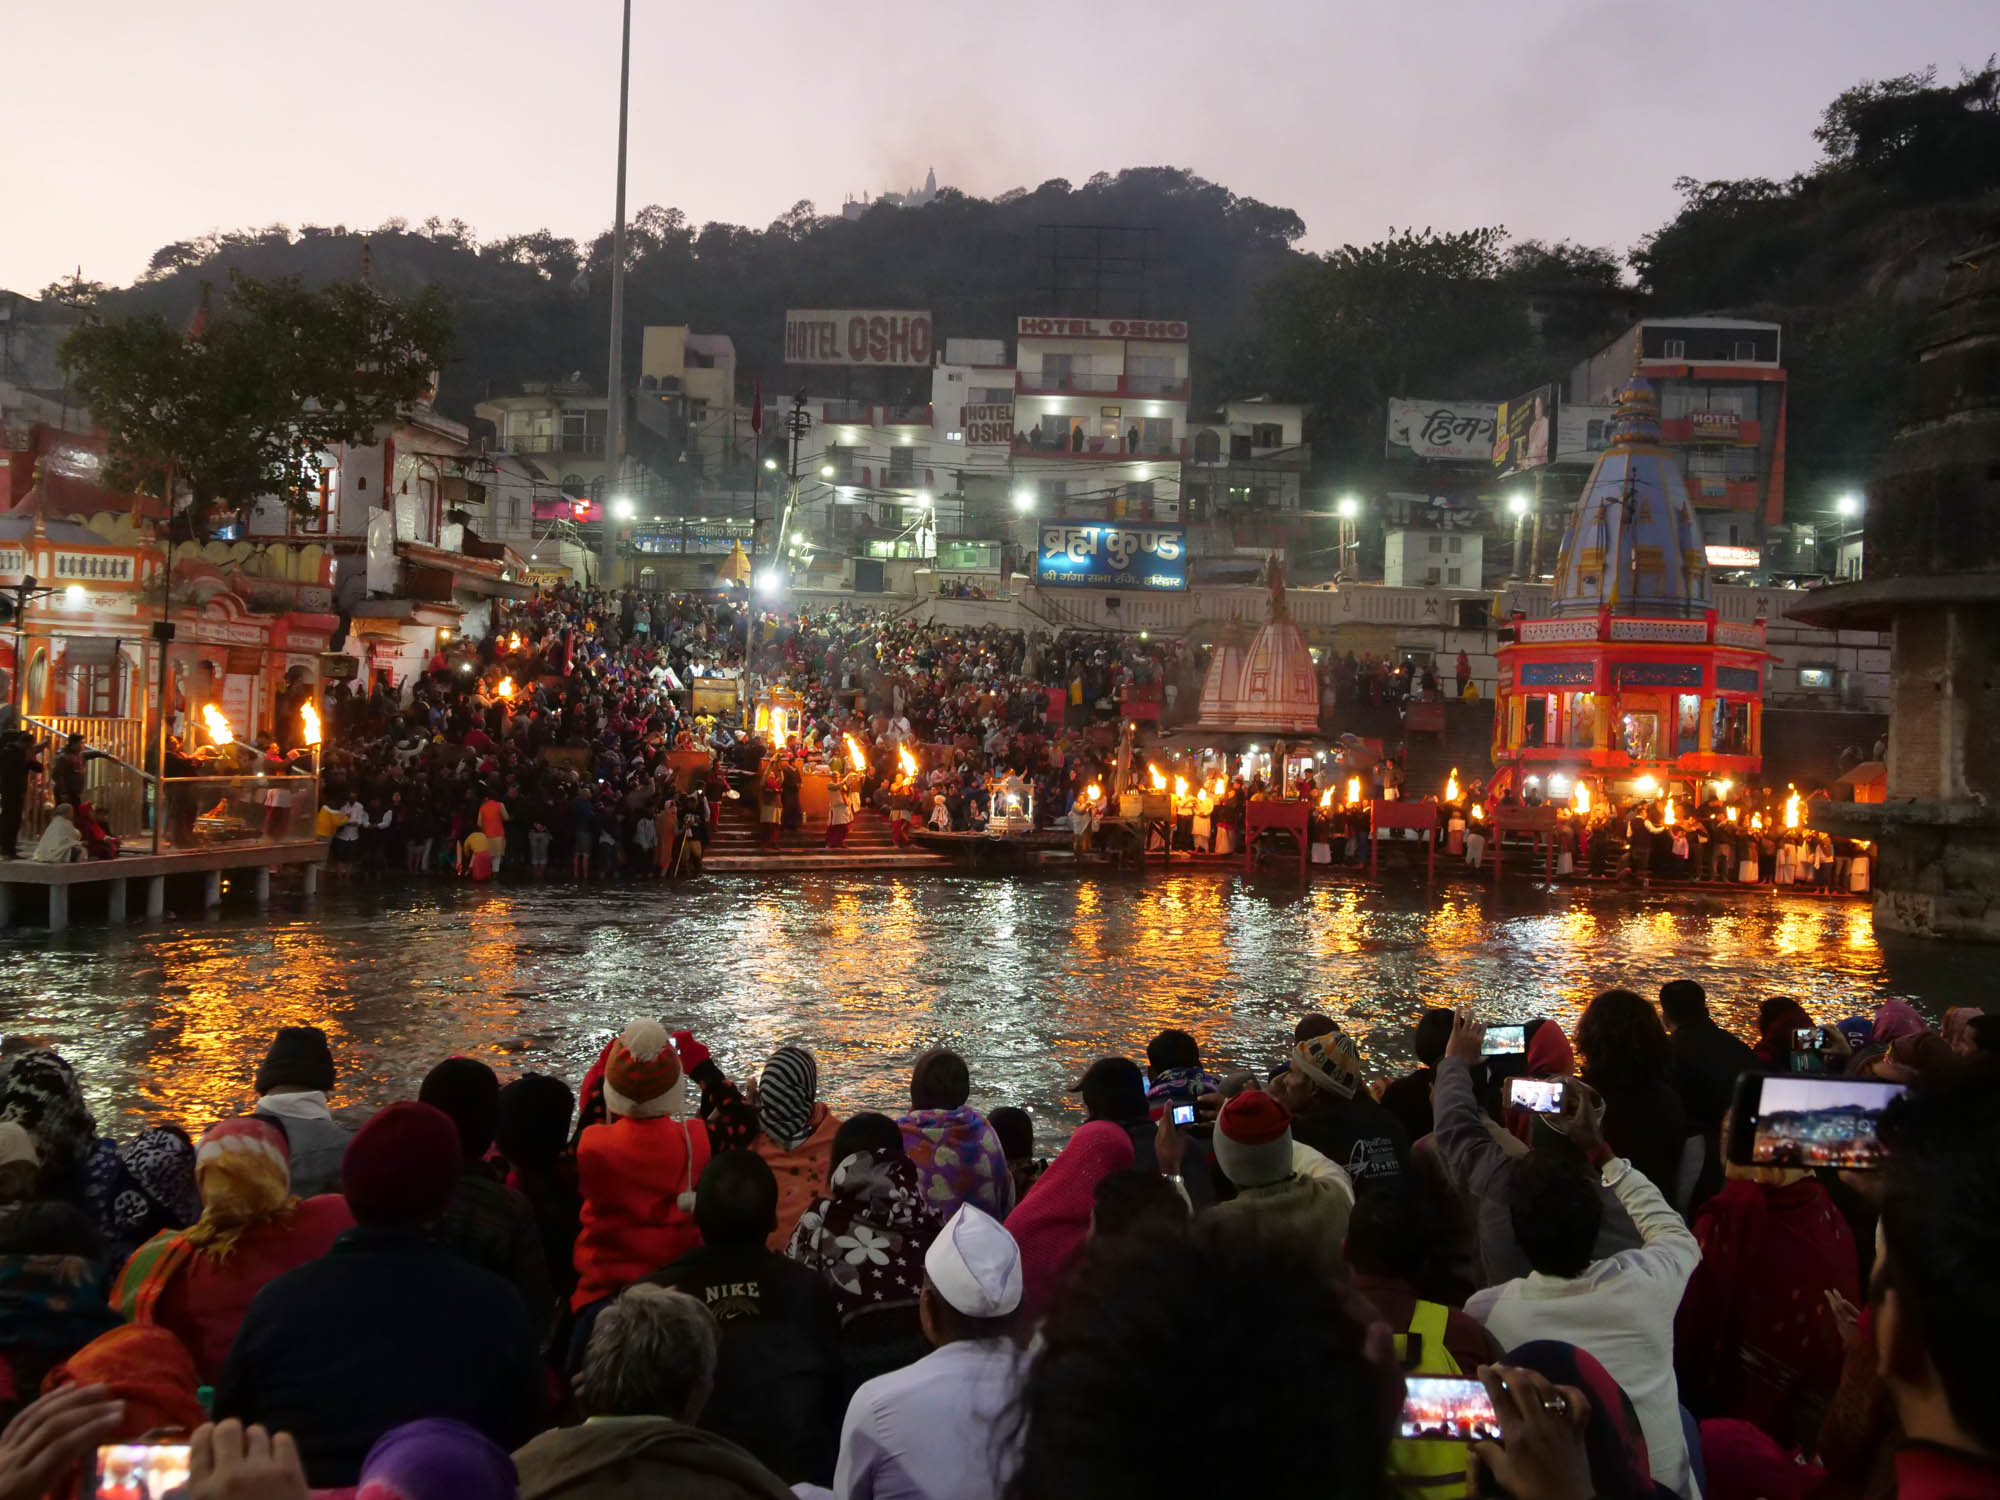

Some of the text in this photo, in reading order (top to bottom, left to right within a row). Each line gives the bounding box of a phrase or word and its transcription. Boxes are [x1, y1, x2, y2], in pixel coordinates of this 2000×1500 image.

[1021, 319, 1187, 337] HOTEL OSHO
[788, 316, 931, 362] HOTEL OSHO
[968, 405, 1014, 420] HOTEL
[1693, 414, 1739, 424] HOTEL
[968, 422, 1014, 442] OSHO
[1044, 526, 1183, 569] ब्रह्म कुण्ड
[1060, 571, 1085, 582] गंगा
[704, 1281, 761, 1304] NIKE
